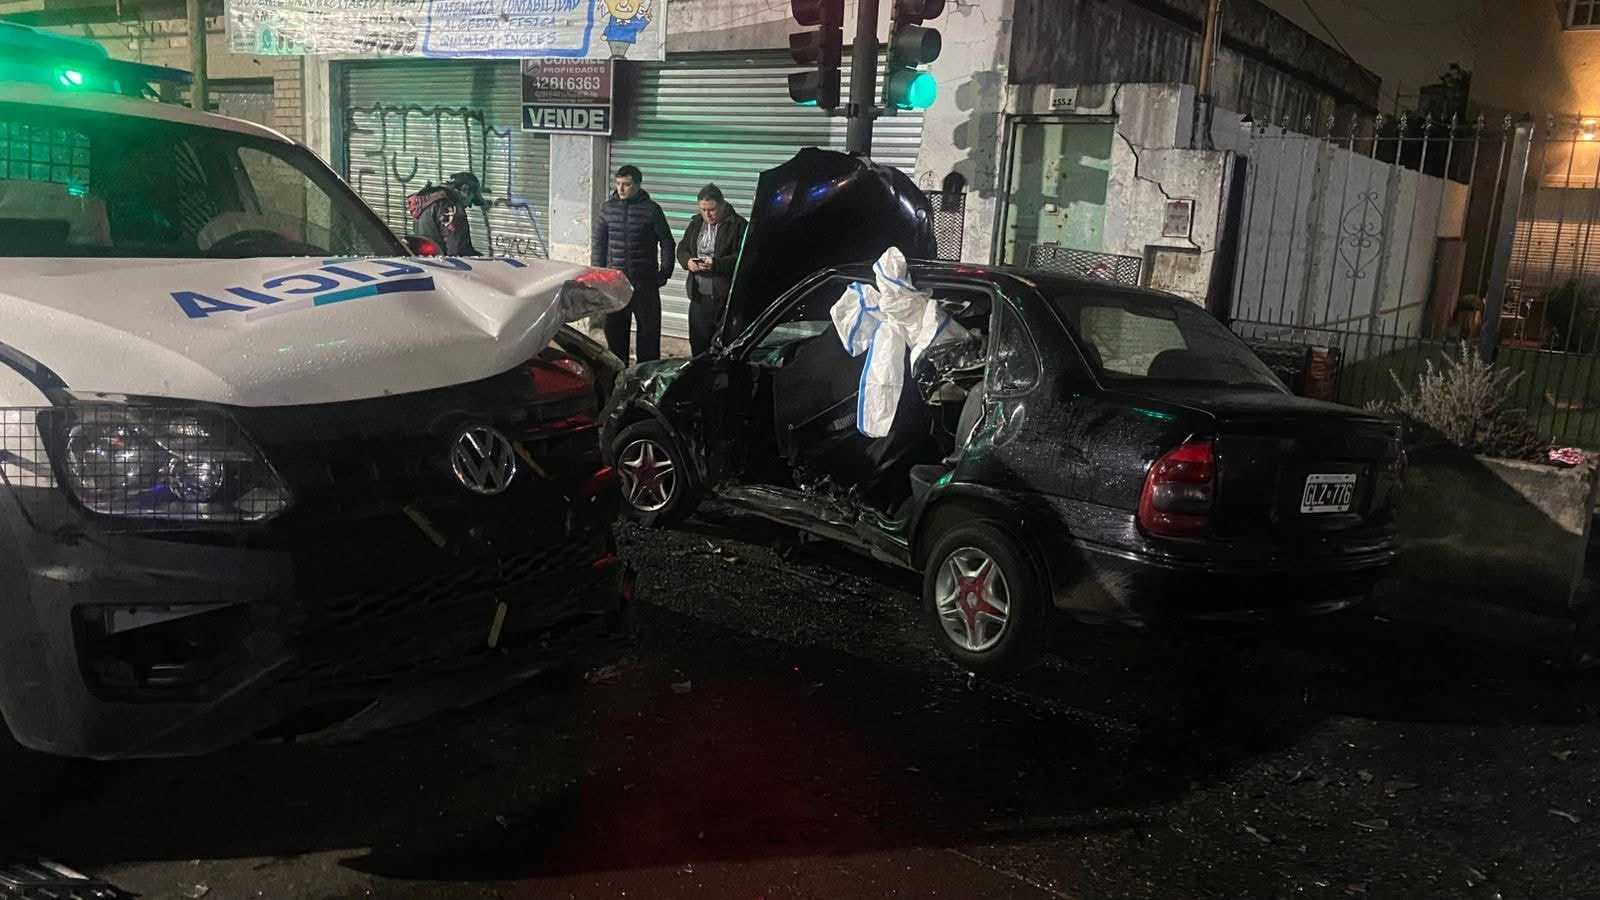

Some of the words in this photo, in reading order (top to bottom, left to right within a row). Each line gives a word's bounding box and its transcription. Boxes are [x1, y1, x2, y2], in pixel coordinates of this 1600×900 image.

[503, 31, 557, 46] INGLES
[528, 107, 605, 130] VENDE
[1331, 484, 1353, 505] 776
